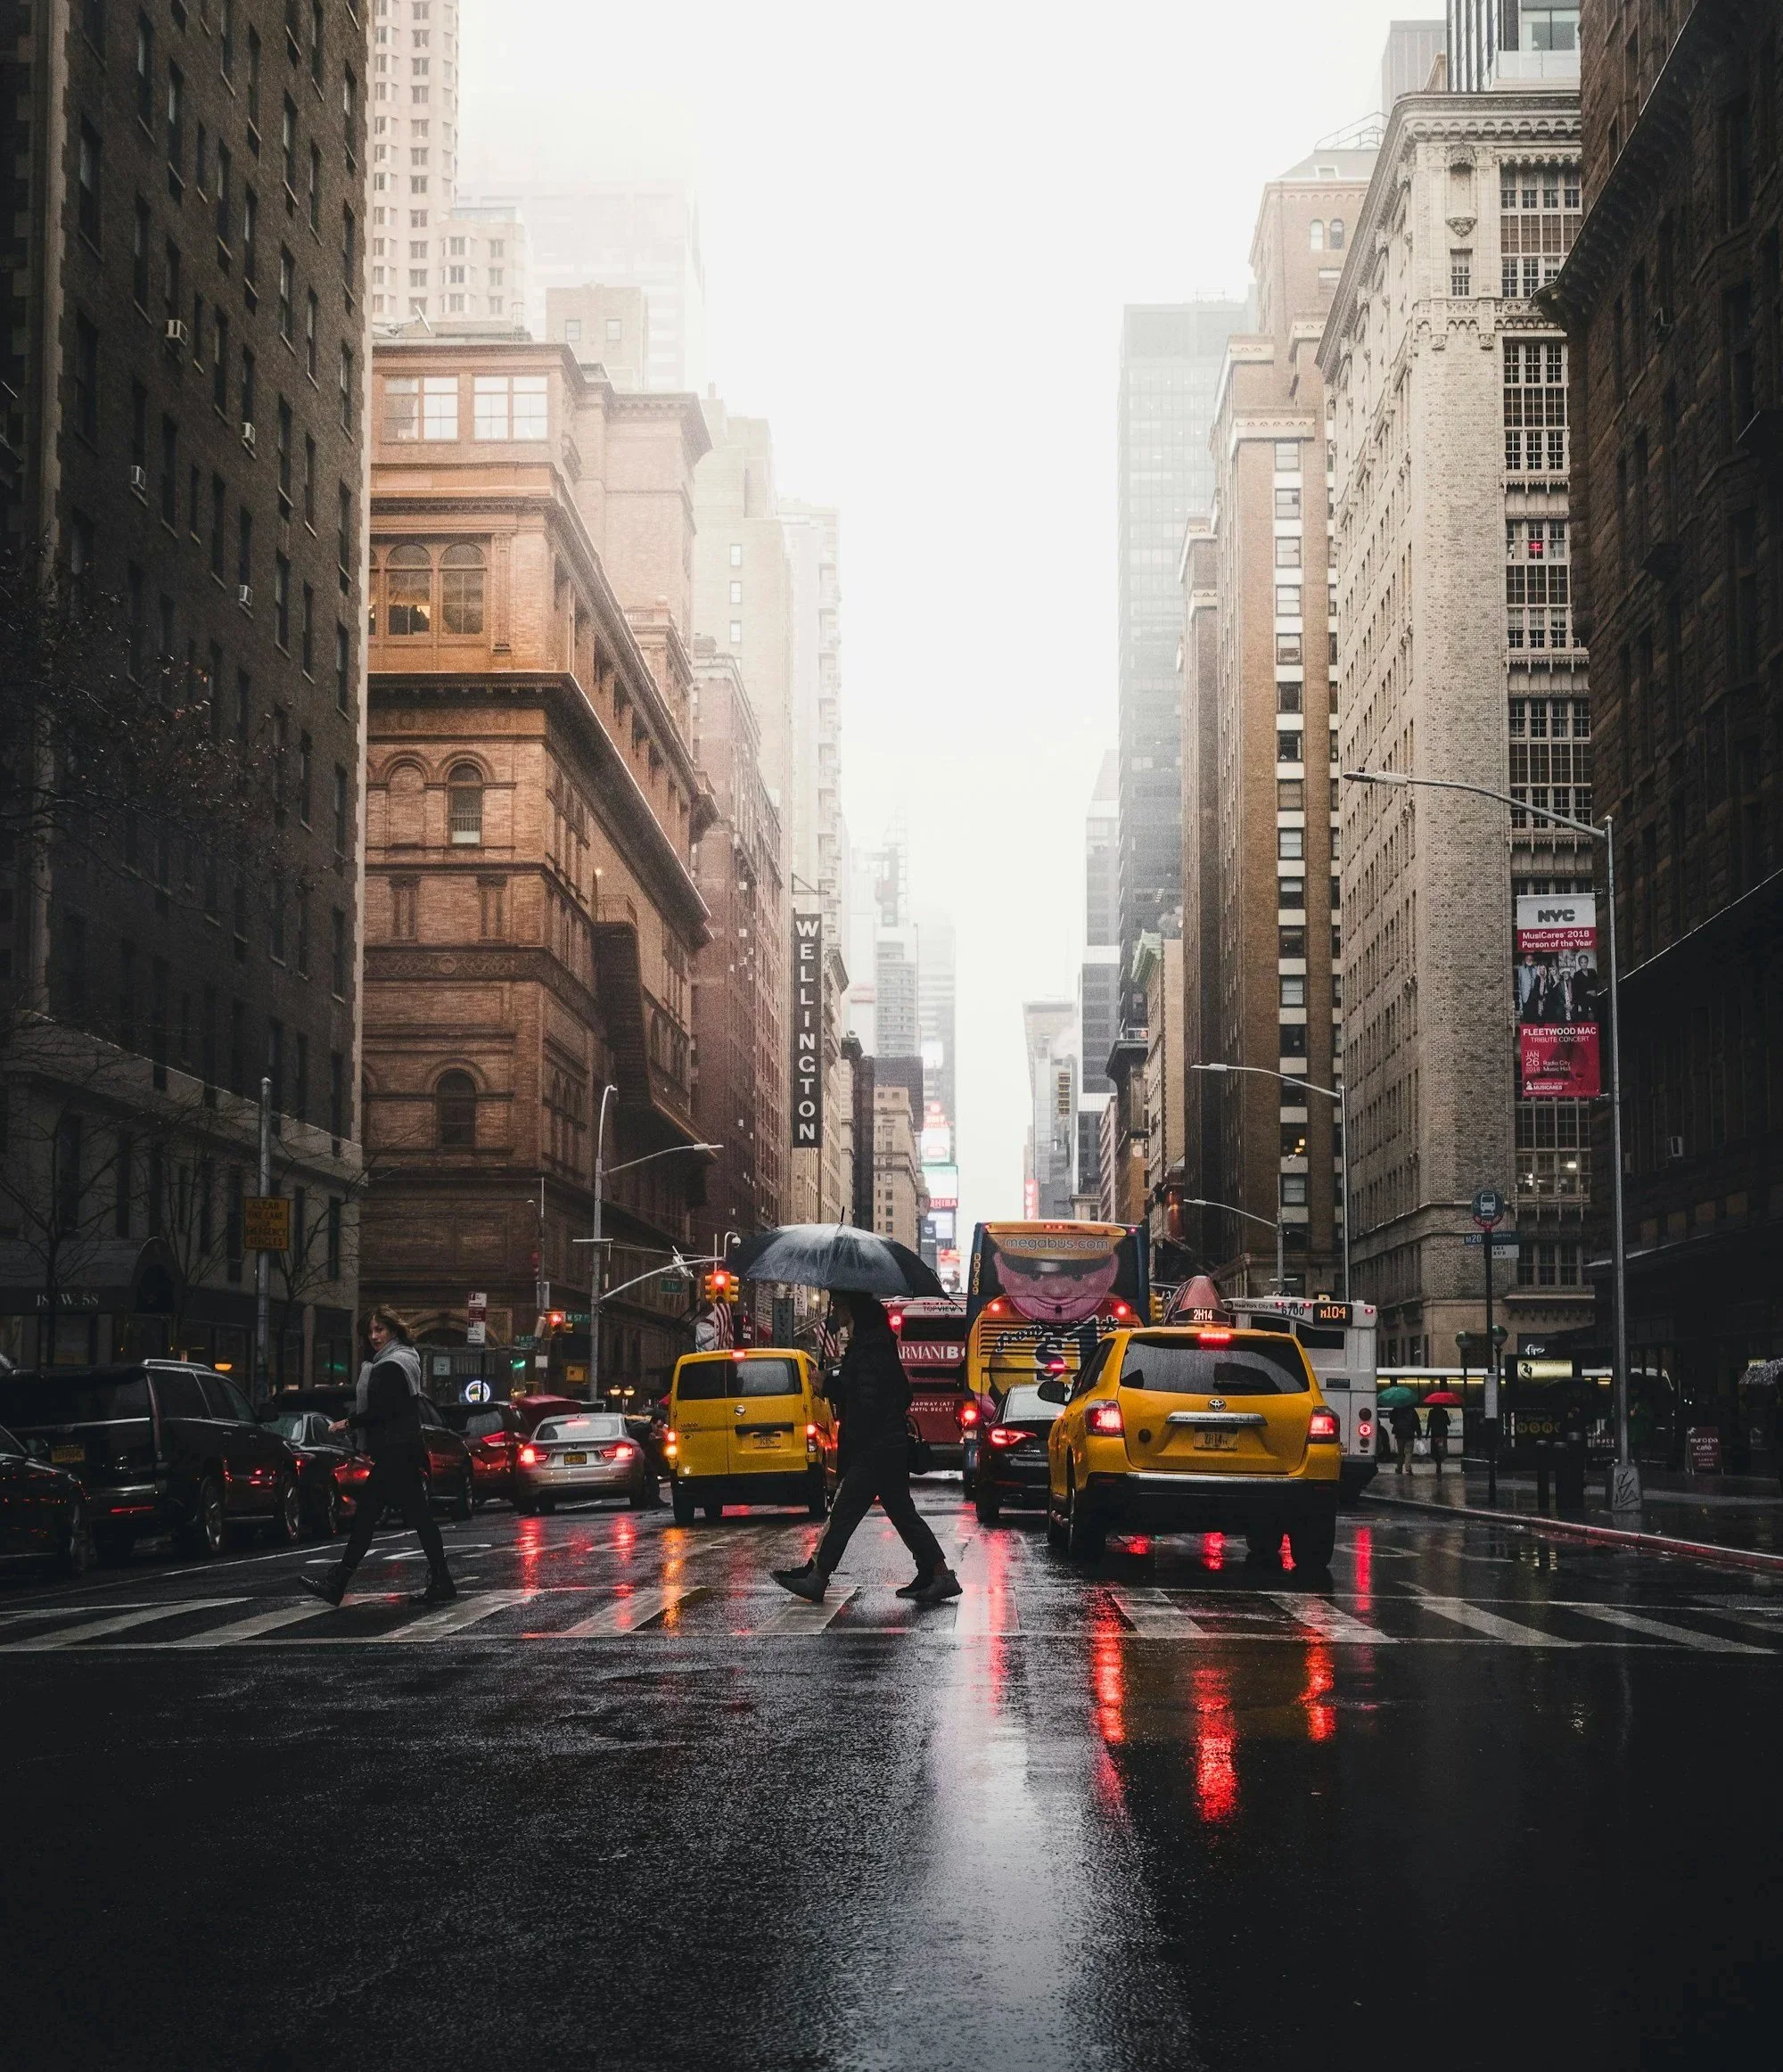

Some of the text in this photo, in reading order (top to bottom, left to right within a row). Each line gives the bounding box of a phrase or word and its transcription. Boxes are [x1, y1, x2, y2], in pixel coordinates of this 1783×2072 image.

[1538, 909, 1575, 923] NYC
[1567, 930, 1590, 938] 2018
[1522, 941, 1549, 950] Person
[1550, 940, 1559, 948] of
[796, 920, 819, 1141] WELLINGTON
[1523, 1027, 1576, 1036] FLEETWOOD
[1525, 1058, 1540, 1066] 26
[1007, 1237, 1108, 1251] megabus.com
[1466, 1234, 1482, 1244] M20
[973, 1253, 982, 1295] DD769
[1193, 1309, 1212, 1320] 2H14
[1281, 1306, 1304, 1316] 6700
[1320, 1306, 1346, 1320] M104
